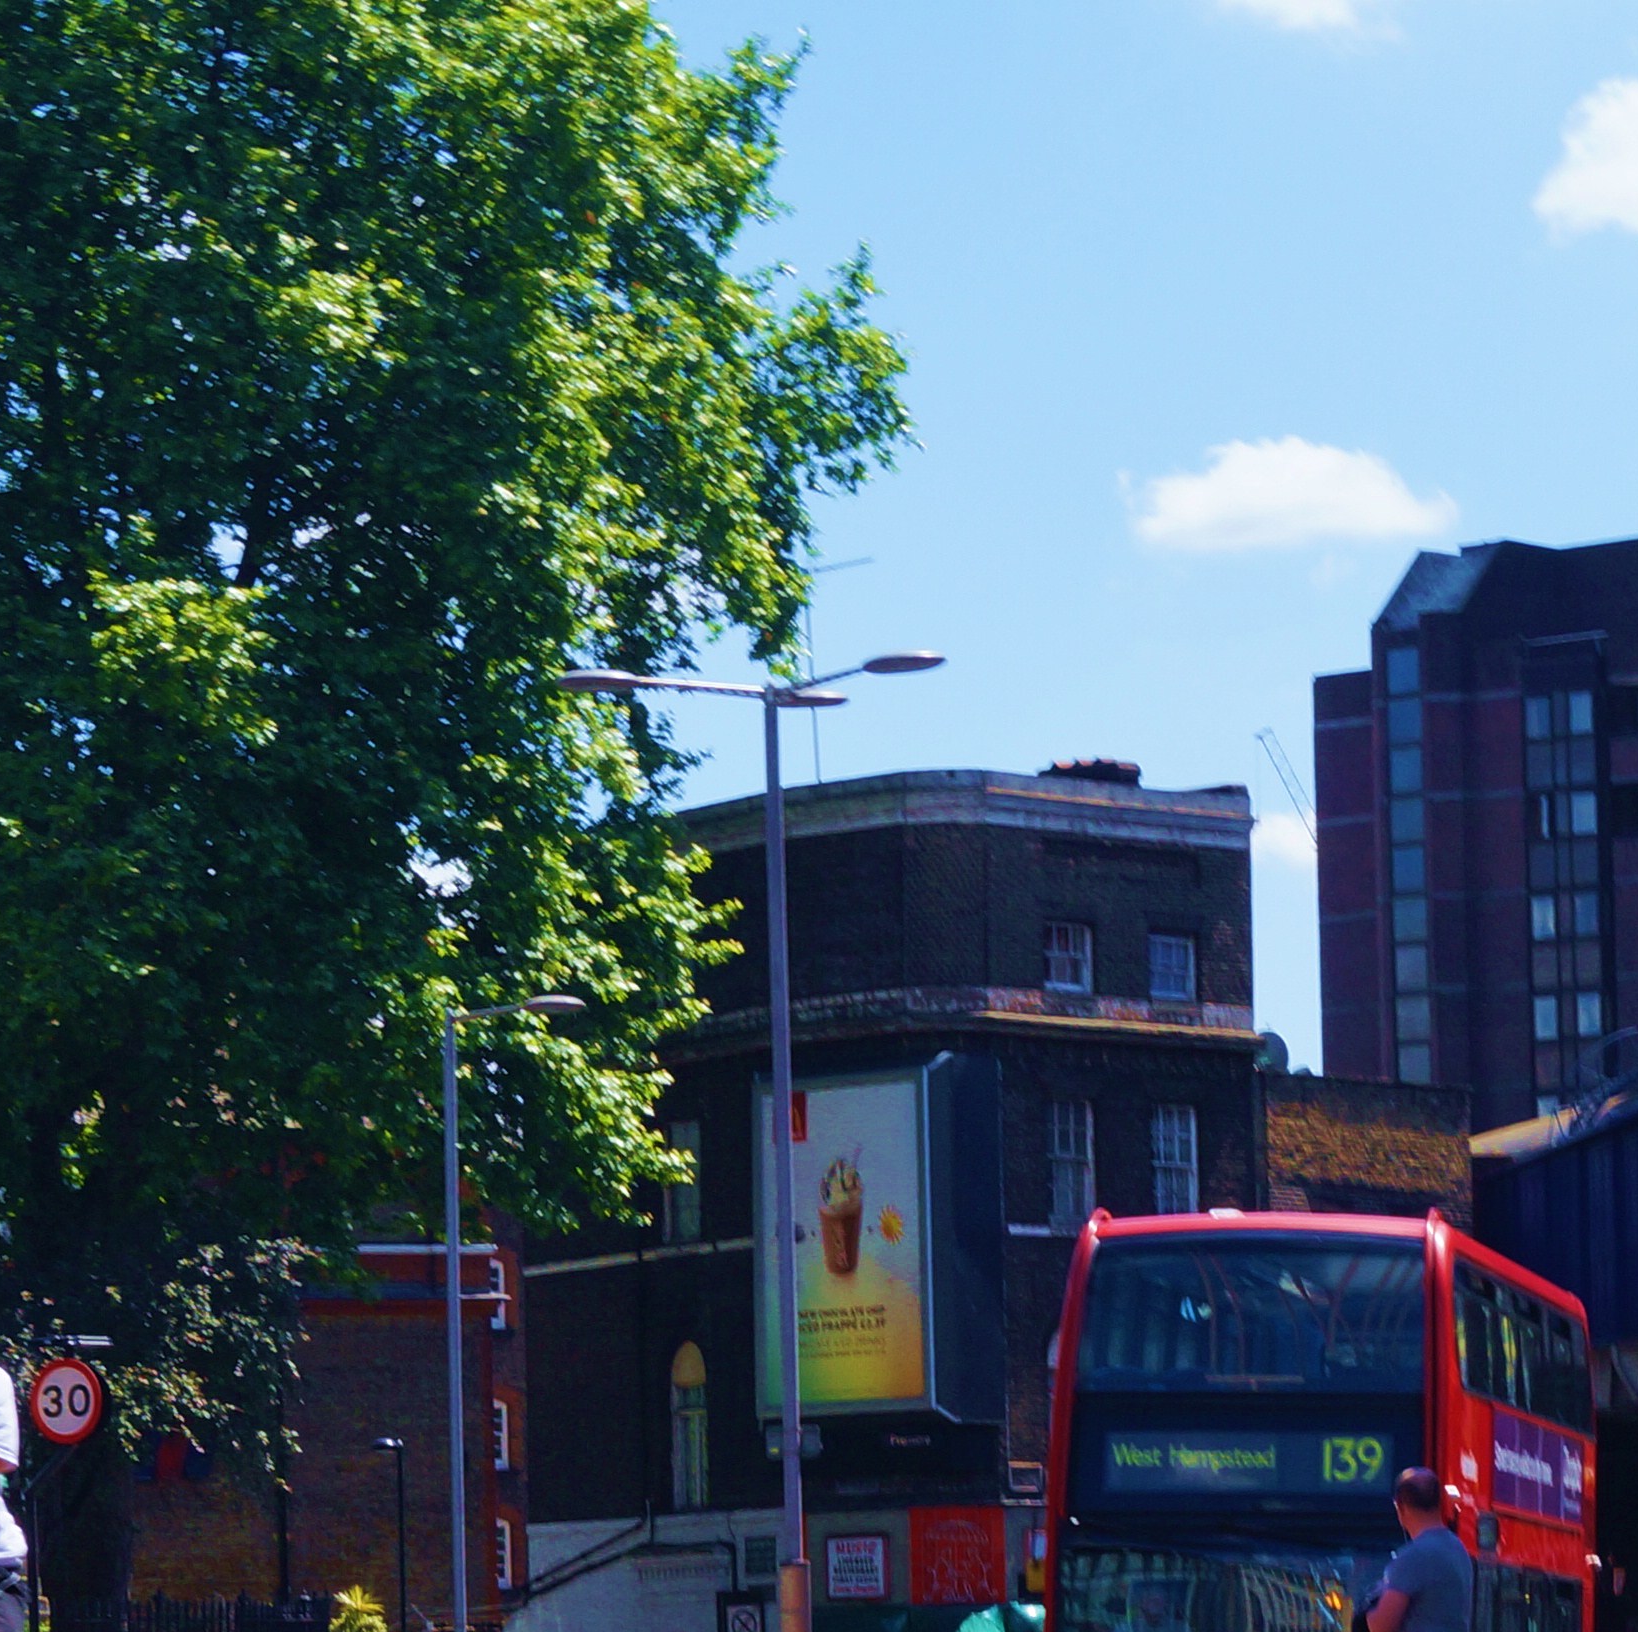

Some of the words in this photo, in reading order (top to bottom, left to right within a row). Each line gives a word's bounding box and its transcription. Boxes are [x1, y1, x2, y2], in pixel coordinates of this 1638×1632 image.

[42, 1383, 92, 1419] 30
[1112, 1442, 1163, 1468] West
[1168, 1442, 1277, 1474] Hampstead
[1321, 1436, 1384, 1482] 139
